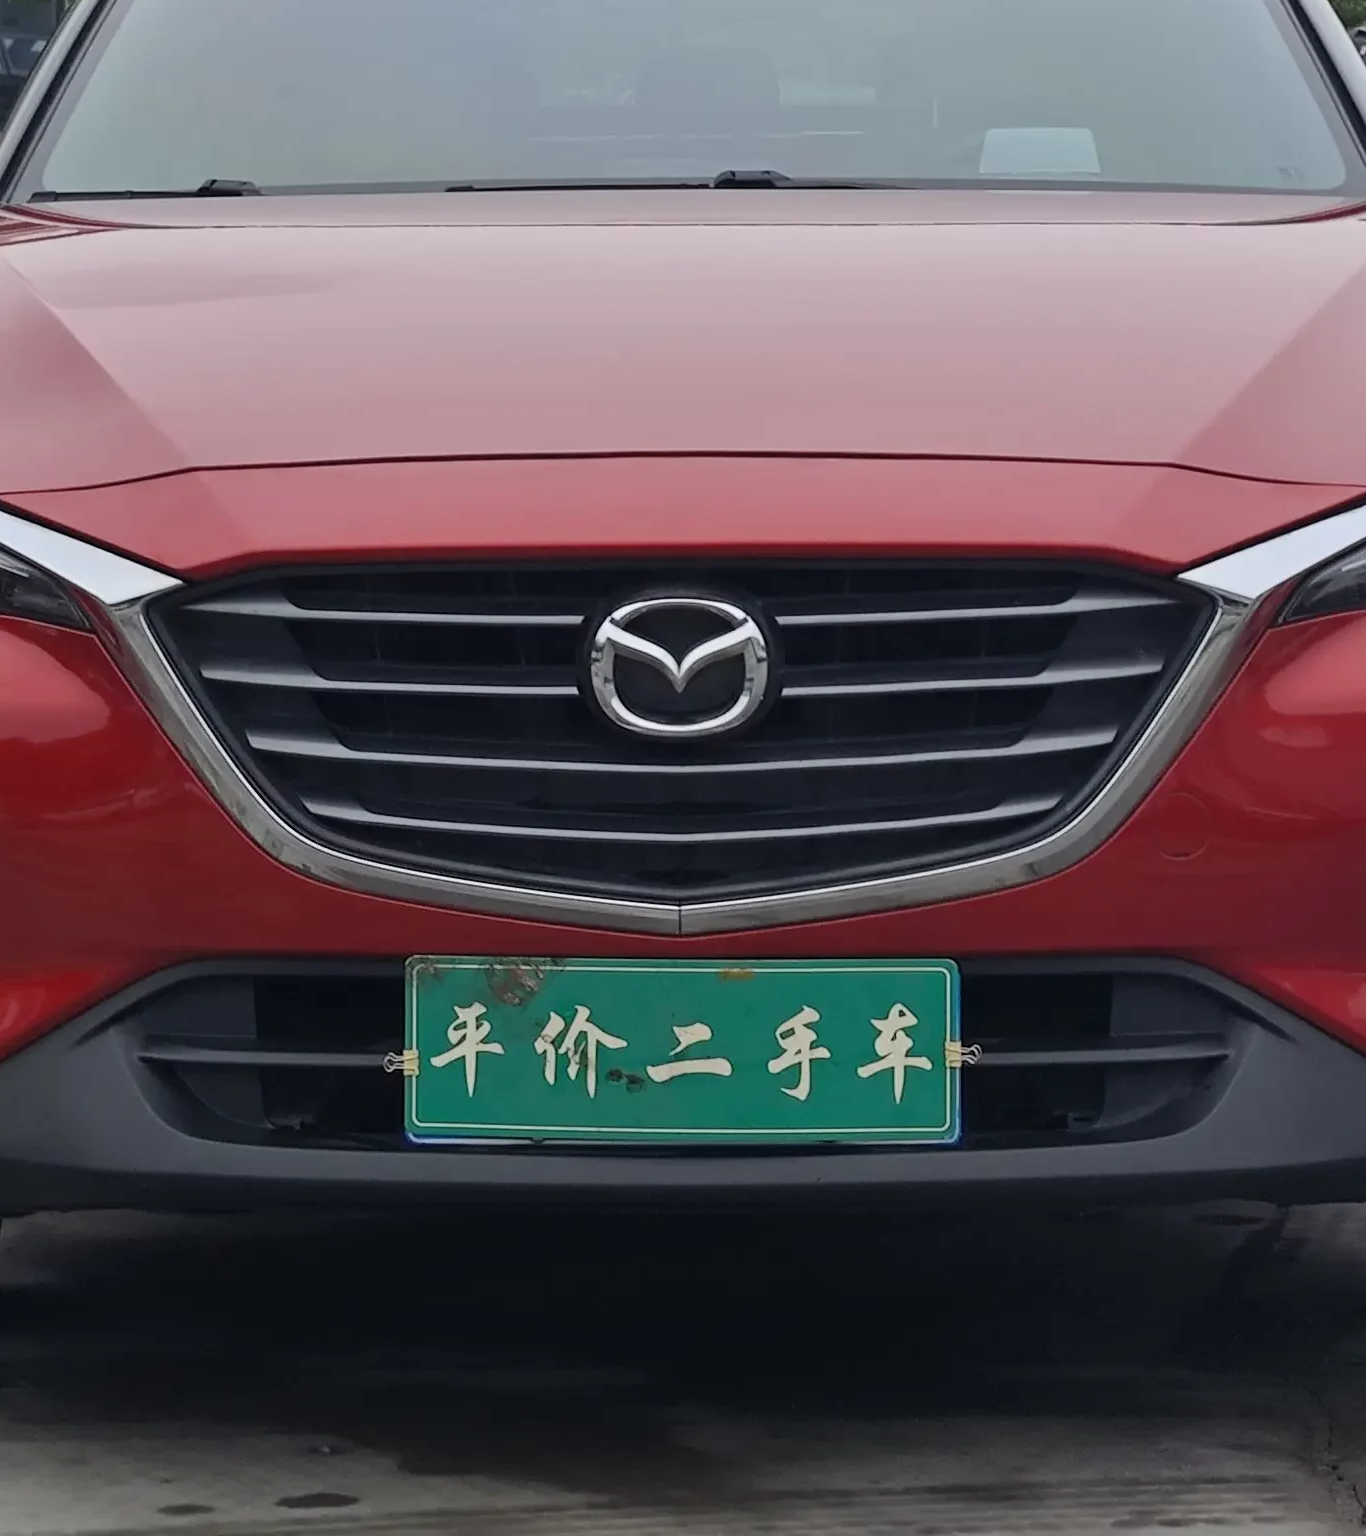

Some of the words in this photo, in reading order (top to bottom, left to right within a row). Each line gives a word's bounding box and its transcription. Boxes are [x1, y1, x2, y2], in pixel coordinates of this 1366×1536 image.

[429, 1001, 933, 1105] 平价二手车
